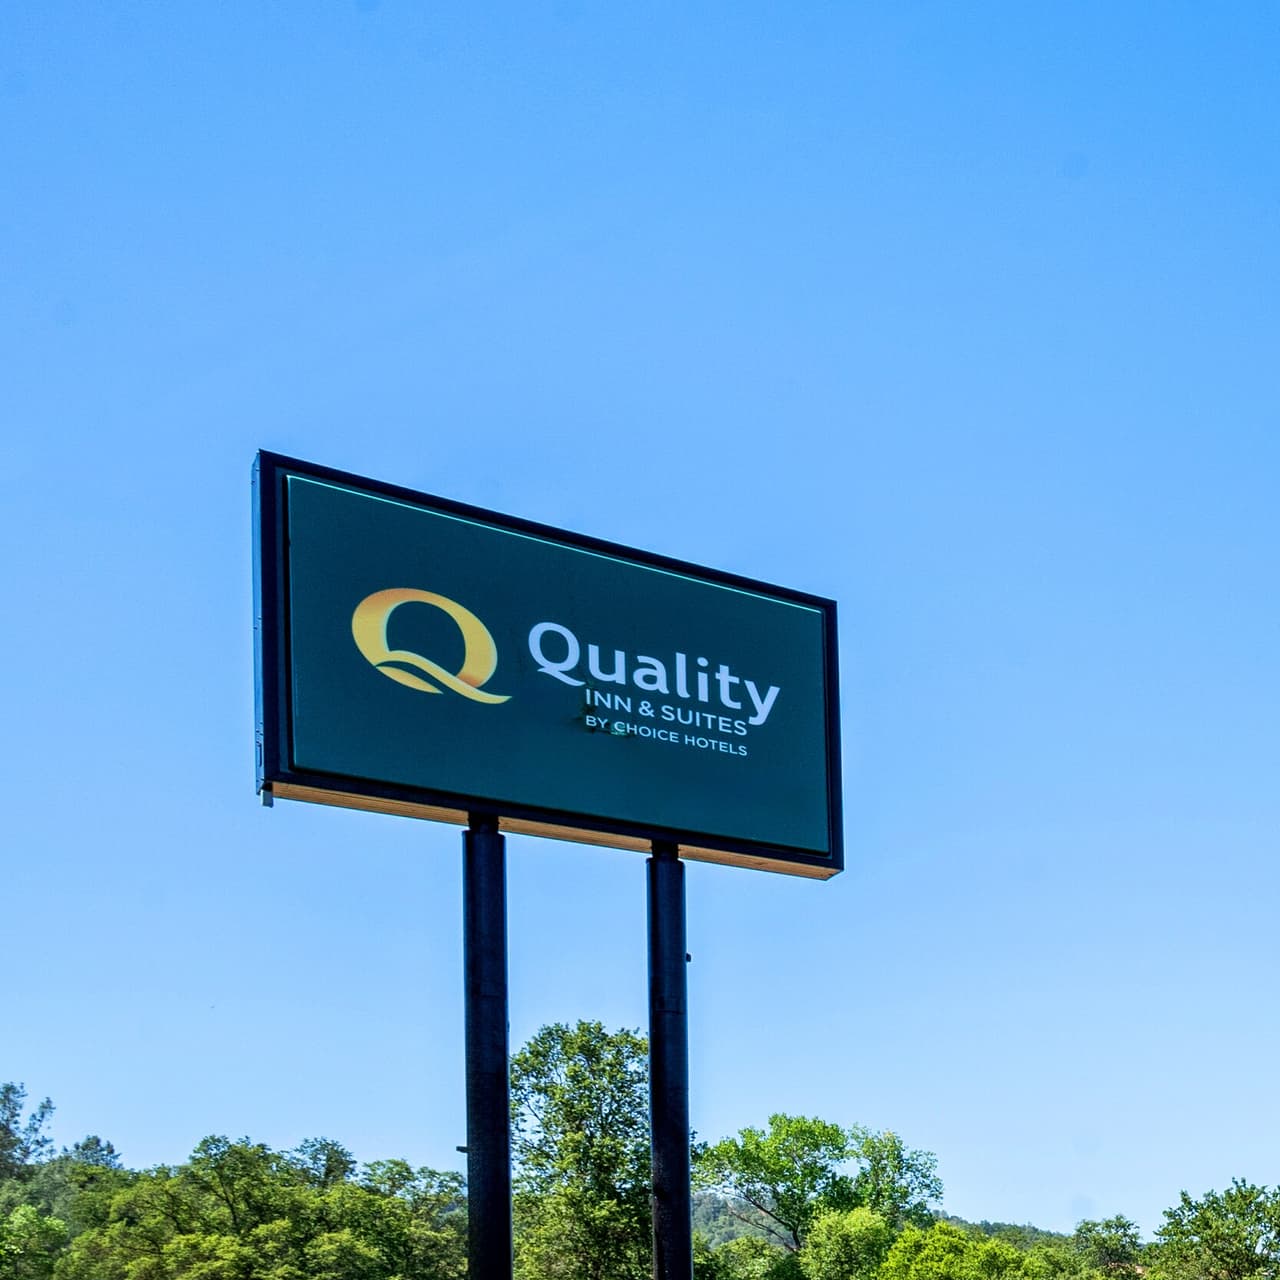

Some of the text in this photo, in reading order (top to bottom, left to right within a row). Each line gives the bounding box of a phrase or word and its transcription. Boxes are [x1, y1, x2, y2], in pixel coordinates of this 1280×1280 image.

[352, 587, 512, 704] Q
[528, 621, 781, 726] Quality
[585, 688, 748, 736] INN & SUITES
[585, 715, 748, 757] BY CHOICE HOTELS
